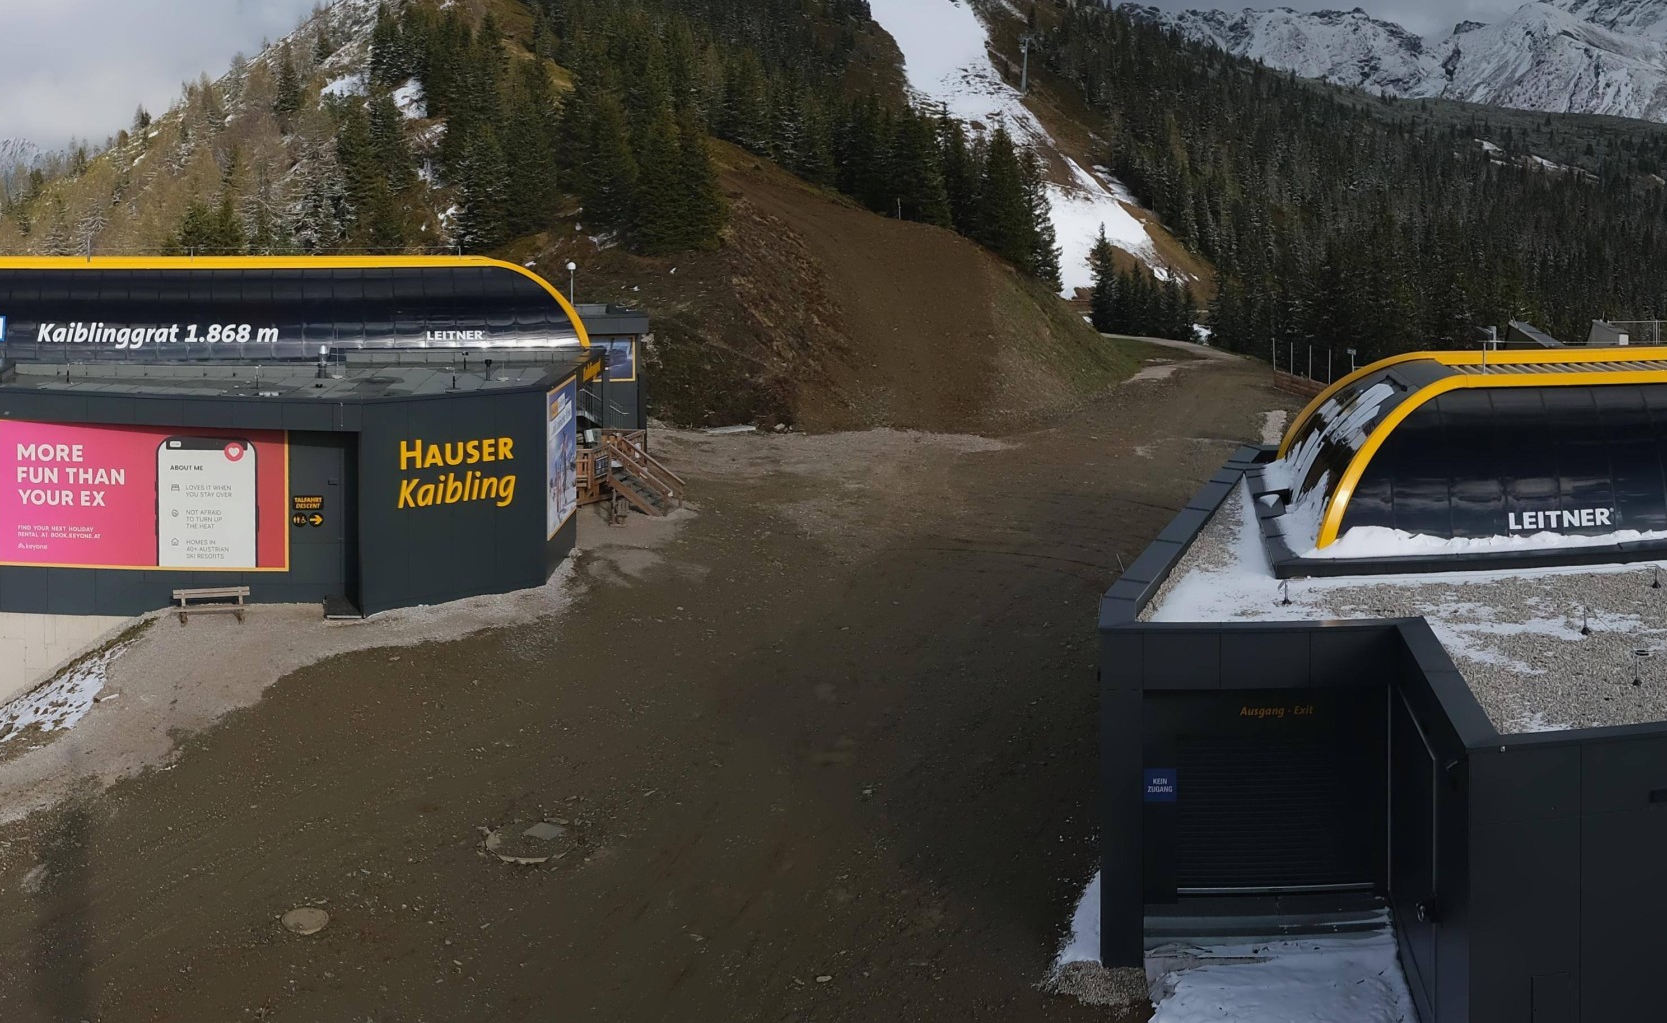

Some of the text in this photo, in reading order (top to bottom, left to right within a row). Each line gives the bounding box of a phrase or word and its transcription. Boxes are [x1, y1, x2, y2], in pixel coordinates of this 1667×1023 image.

[37, 322, 279, 349] Kaiblinggrat 1.868 m
[426, 330, 484, 341] LEITNER
[17, 443, 84, 462] MORE
[400, 437, 514, 470] HAUSER
[17, 467, 125, 485] FUN THAN
[18, 489, 106, 507] YOUR EX
[397, 471, 516, 509] Kaibling
[1508, 507, 1612, 530] LEITNER
[1239, 706, 1285, 718] Ausgang
[1293, 705, 1314, 715] Exit
[1147, 785, 1173, 793] ZUGANG
[1152, 777, 1168, 785] KEIN
